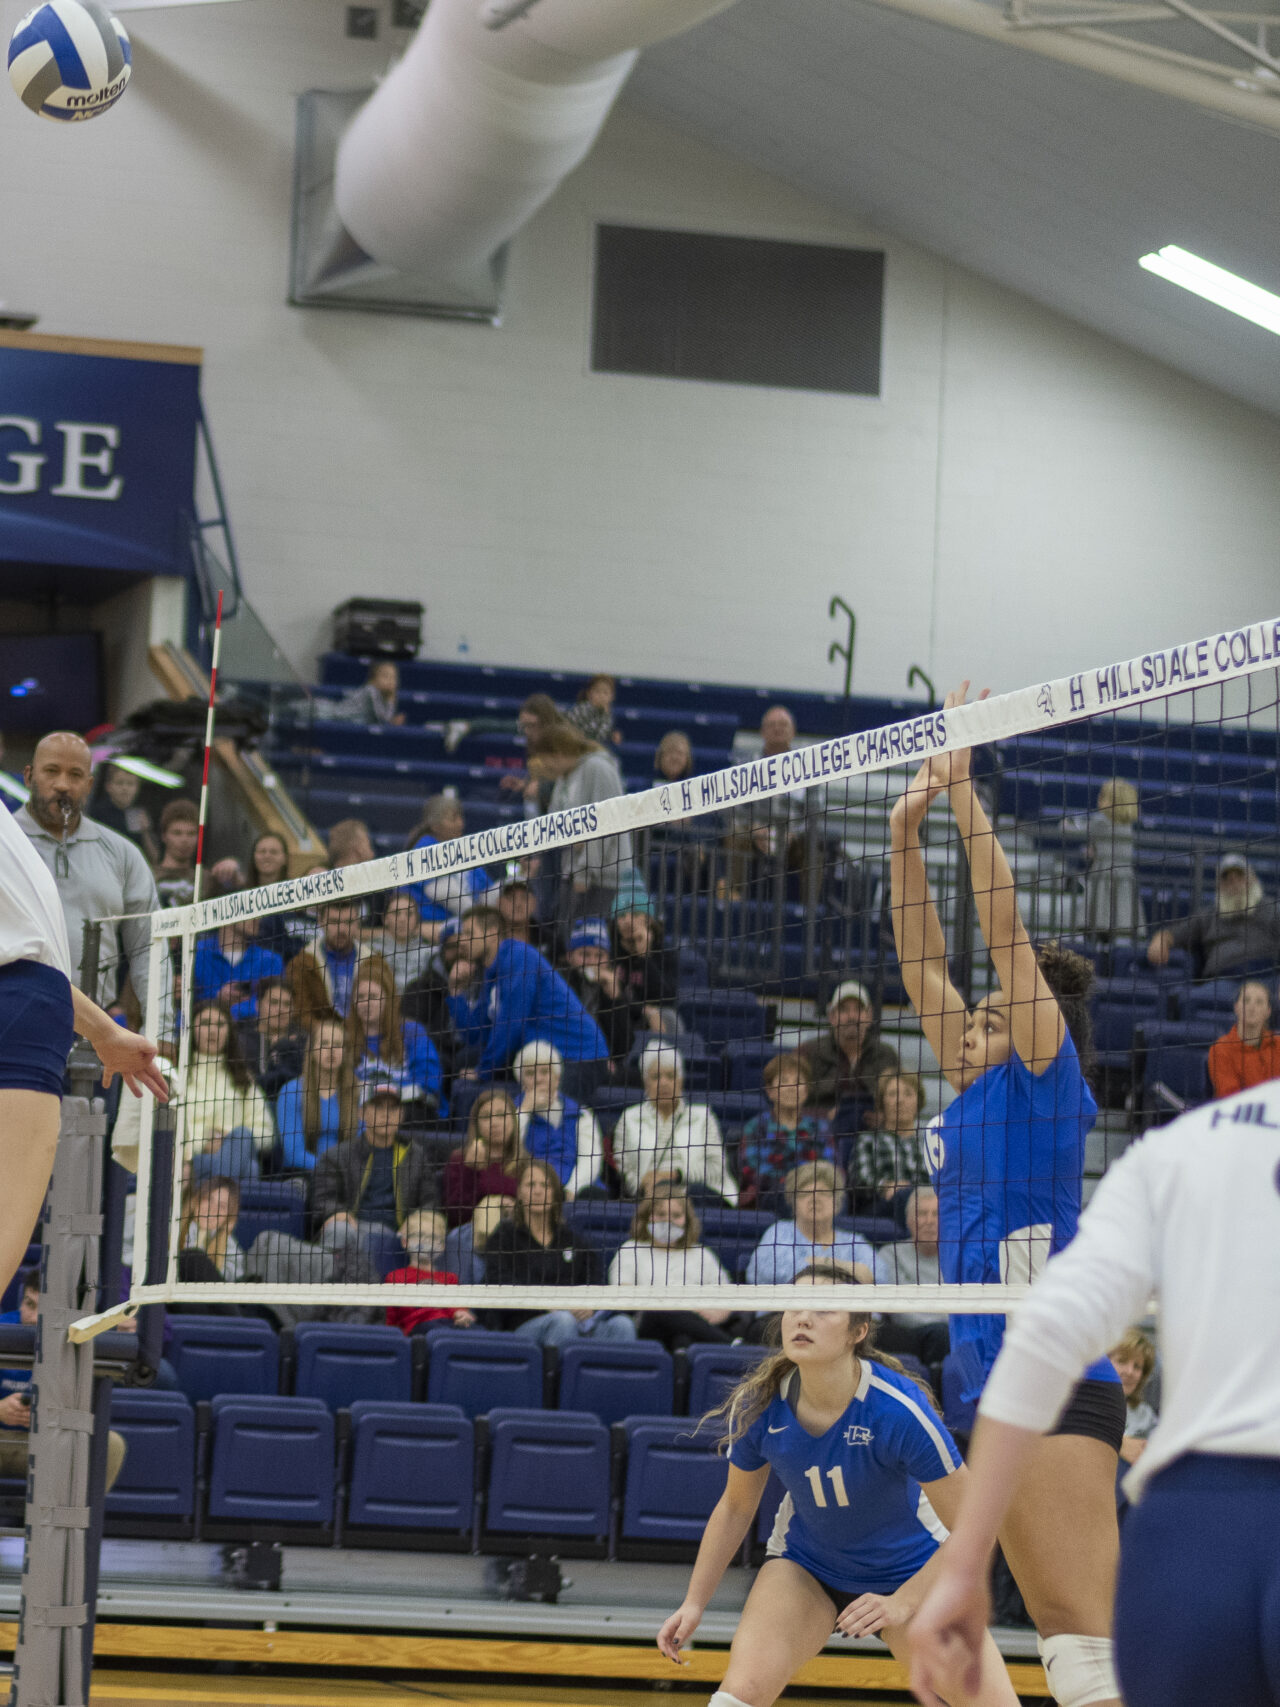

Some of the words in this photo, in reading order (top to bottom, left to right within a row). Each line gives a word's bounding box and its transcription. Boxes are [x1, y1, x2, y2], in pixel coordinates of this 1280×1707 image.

[67, 77, 125, 106] molten
[1070, 674, 1085, 711] H
[1097, 640, 1209, 704] HILLSDALE
[682, 781, 693, 812] H
[701, 759, 777, 807] HILLSDALE
[781, 739, 852, 785] COLLEGE
[856, 713, 947, 767] CHARGERS
[406, 852, 414, 878] H
[421, 835, 476, 874] HILLSDALE
[478, 823, 529, 858] COLLEGE
[532, 805, 598, 846] CHARGERS
[212, 891, 254, 921] HILLSDALE
[256, 881, 294, 911] COLLEGE
[296, 869, 345, 901] CHARGERS
[804, 1465, 850, 1508] 11
